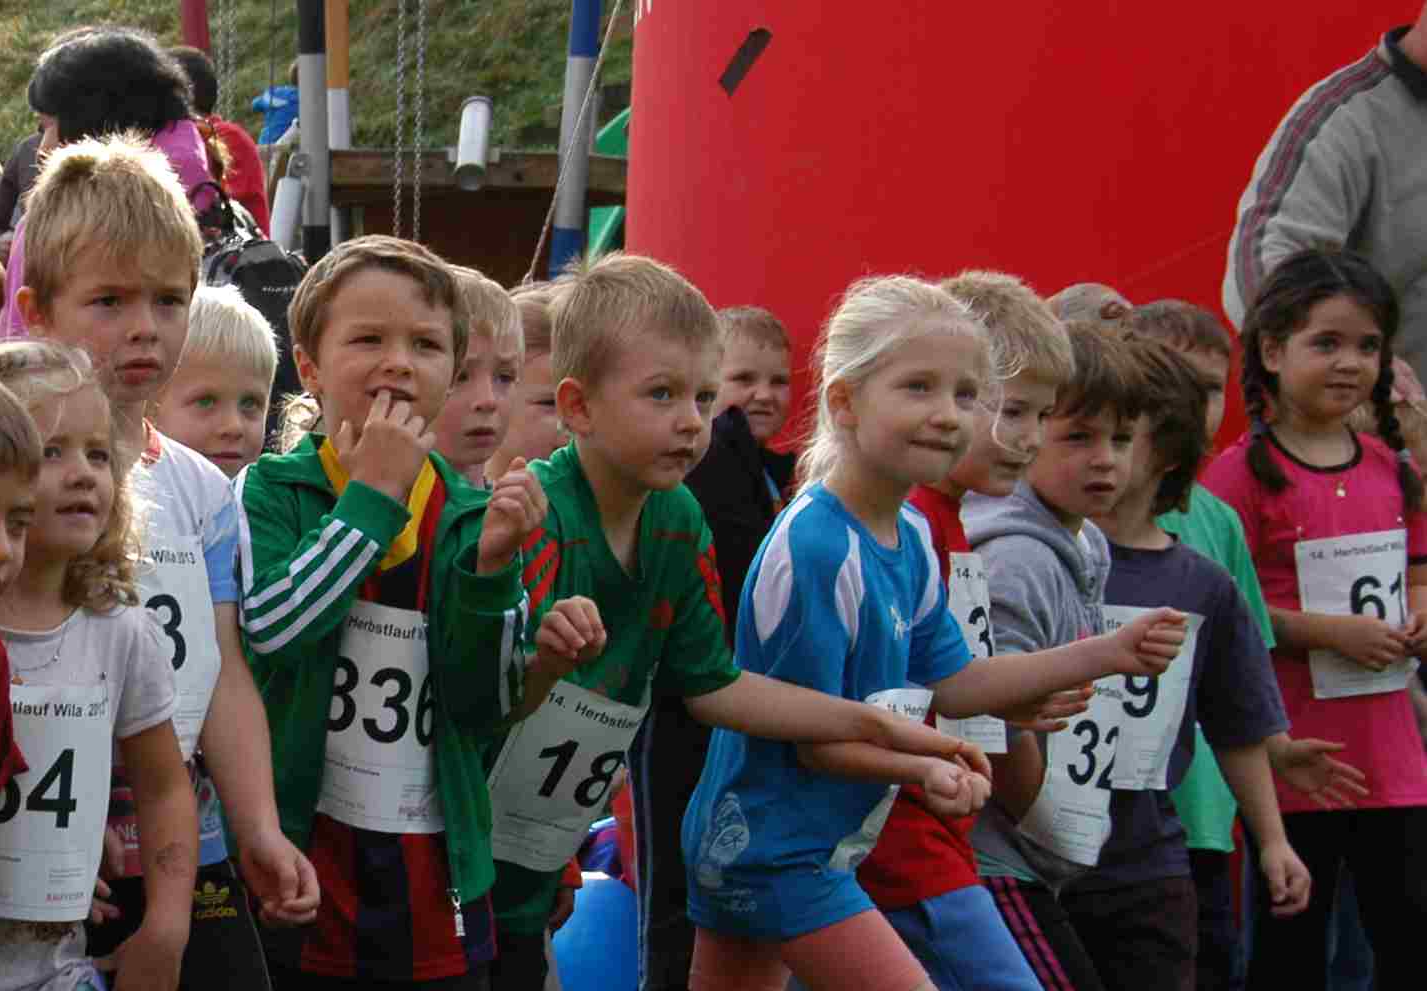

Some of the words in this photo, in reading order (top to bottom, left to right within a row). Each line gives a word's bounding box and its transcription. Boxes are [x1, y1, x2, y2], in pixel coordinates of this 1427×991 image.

[956, 567, 974, 579] 14.
[548, 690, 566, 709] 14.
[53, 702, 83, 718] Wila
[538, 739, 626, 809] 18
